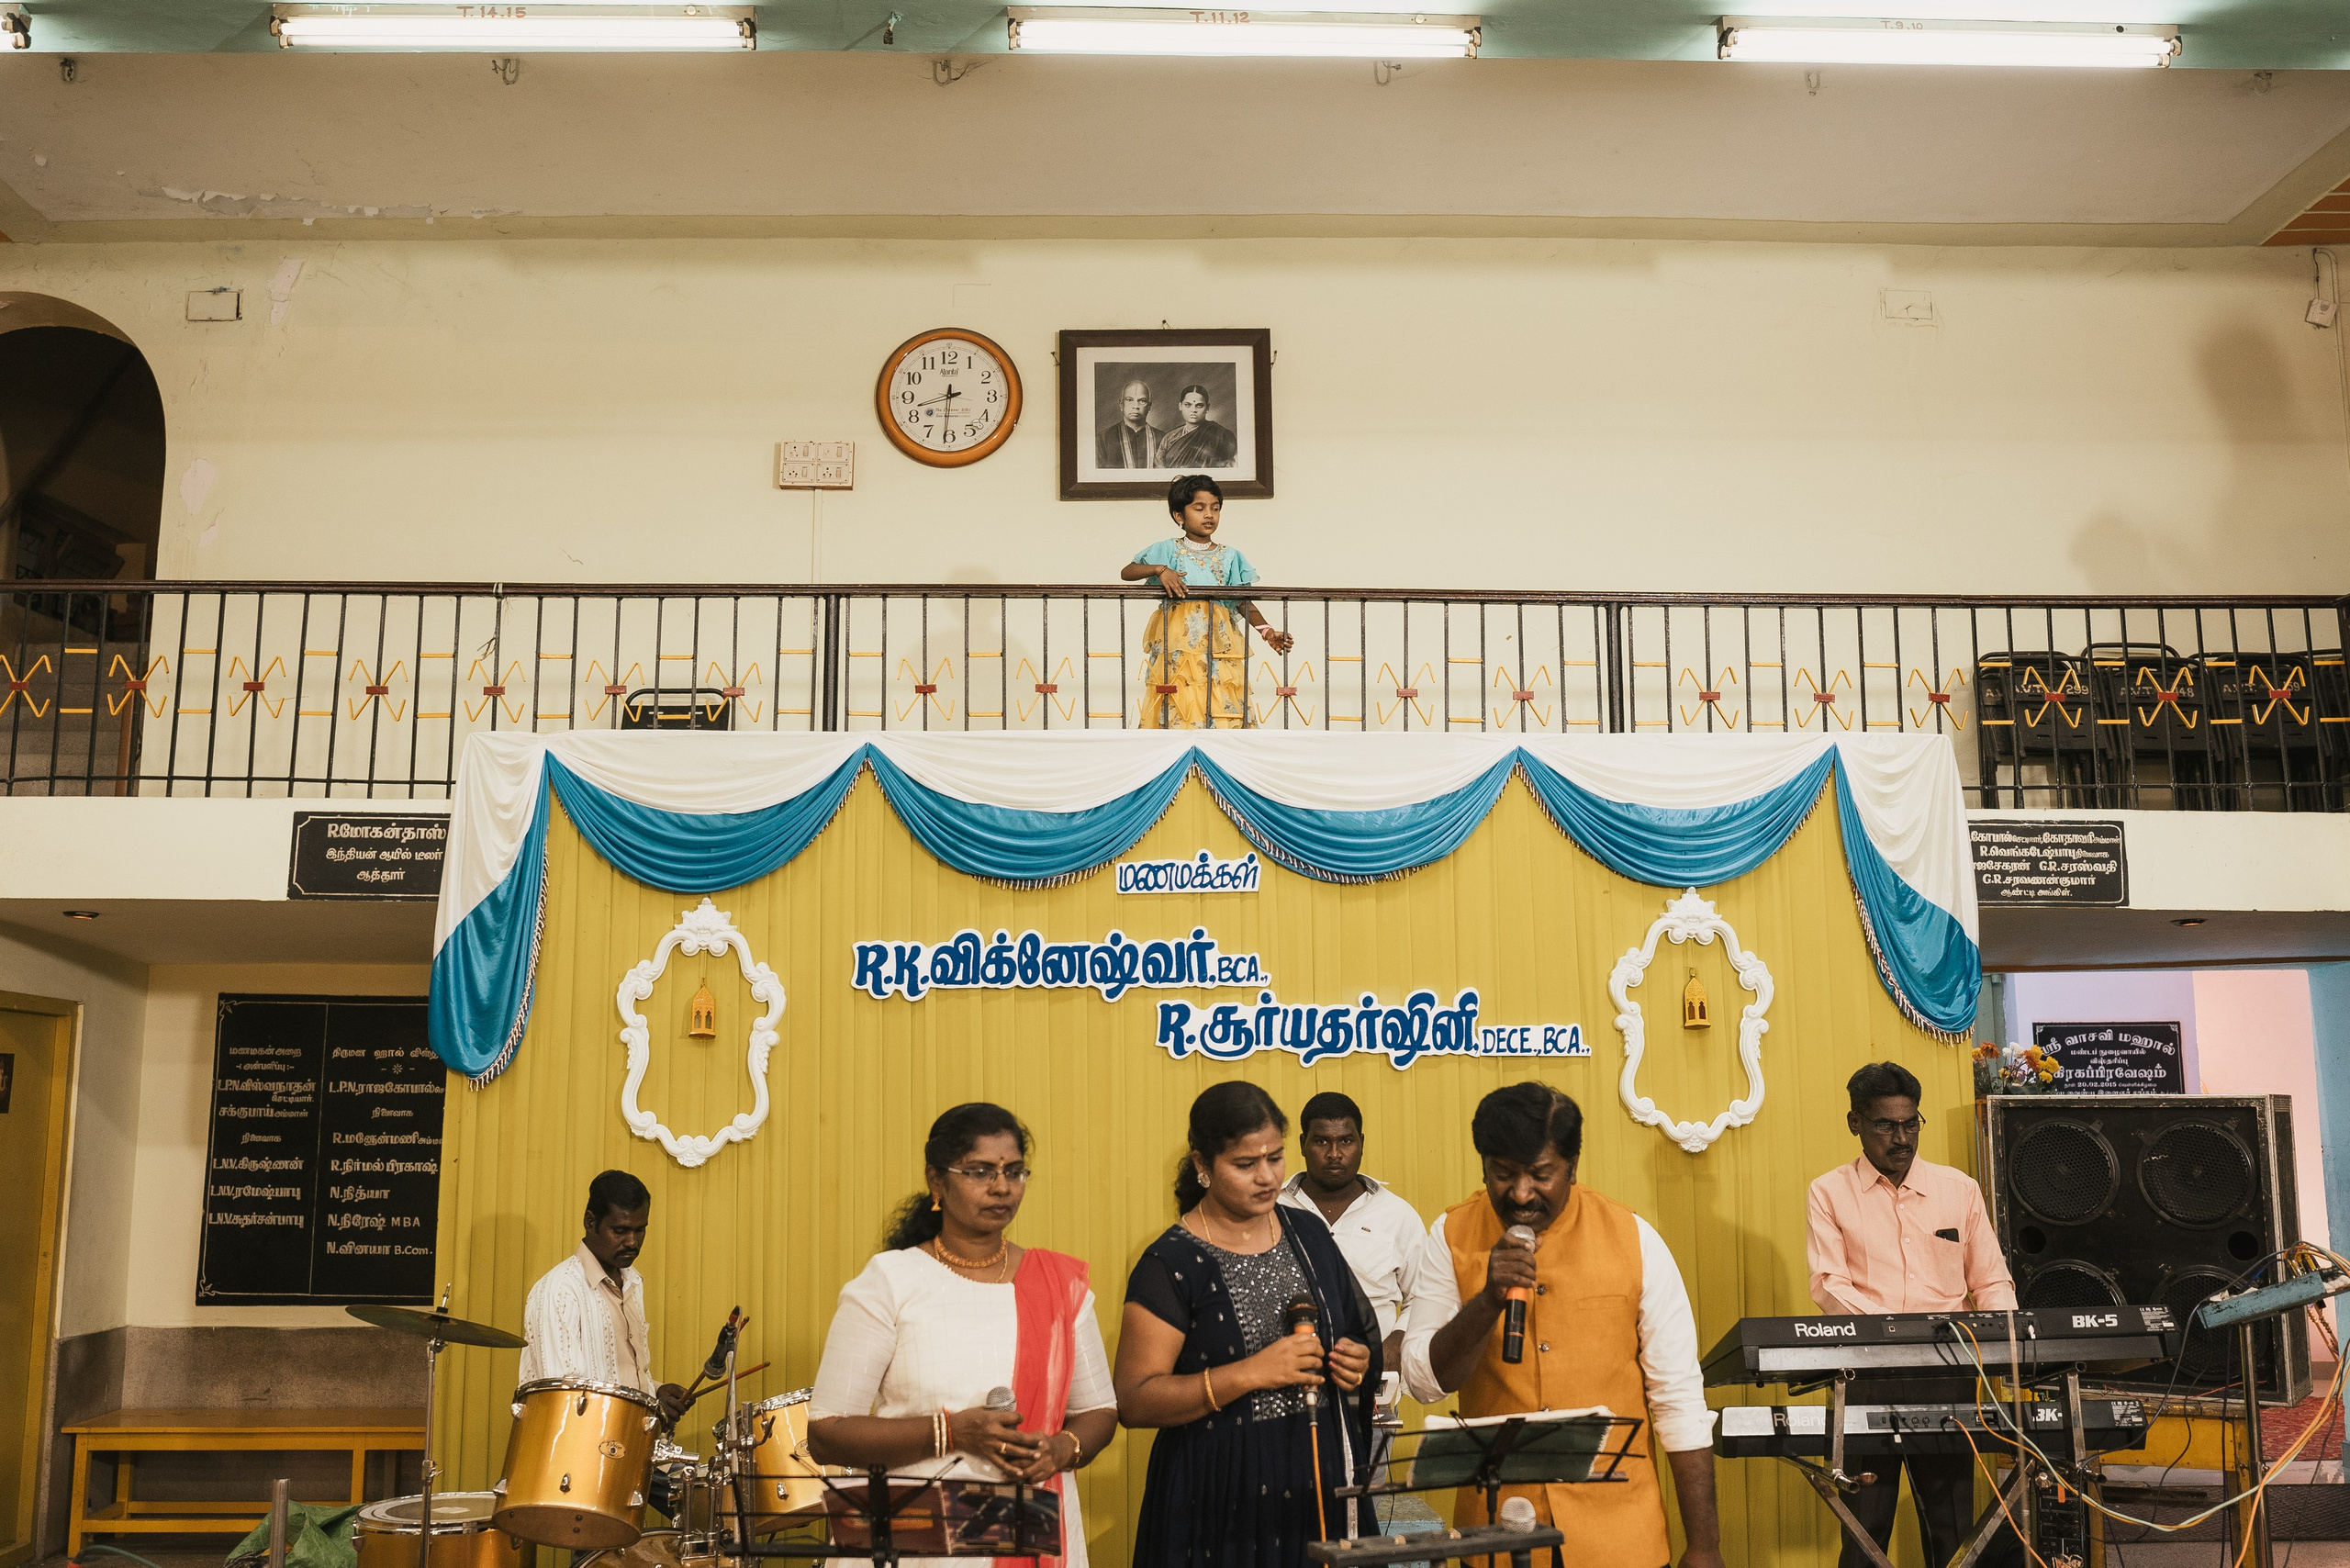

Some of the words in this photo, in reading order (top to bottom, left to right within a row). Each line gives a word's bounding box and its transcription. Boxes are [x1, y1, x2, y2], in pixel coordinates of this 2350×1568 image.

[456, 6, 526, 18] T.14.15
[922, 356, 936, 370] 11
[940, 351, 958, 364] 12
[967, 355, 973, 369] 1
[906, 371, 922, 385] 10
[980, 370, 991, 385] 2
[901, 390, 915, 405] 9
[986, 388, 998, 403] 3
[908, 409, 920, 423] 8
[979, 409, 990, 422] 4
[923, 424, 934, 439] 7
[943, 429, 957, 443] 6
[964, 423, 977, 437] 5
[326, 846, 377, 863] இந்தியன்
[1118, 852, 1259, 891] மணமக்கள்
[1794, 1321, 1857, 1338] Roland
[2072, 1314, 2118, 1328] BK-5
